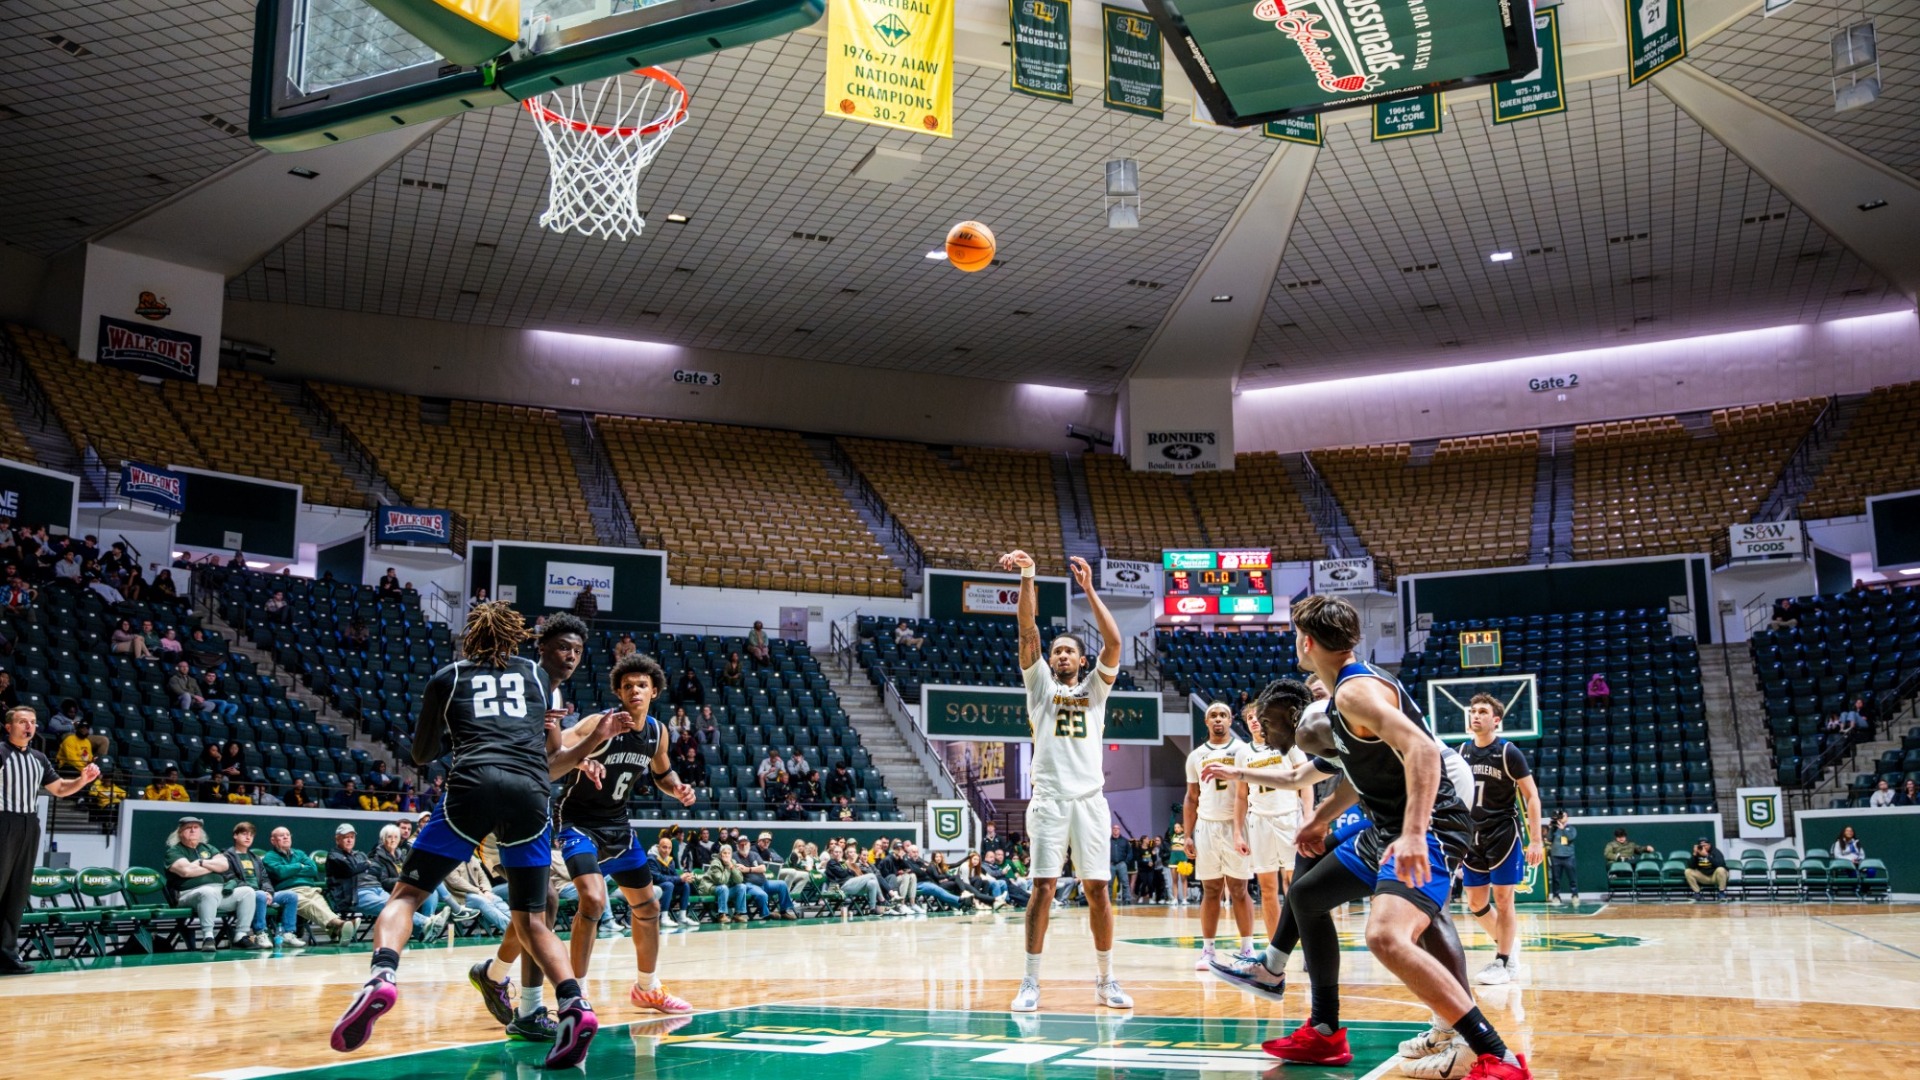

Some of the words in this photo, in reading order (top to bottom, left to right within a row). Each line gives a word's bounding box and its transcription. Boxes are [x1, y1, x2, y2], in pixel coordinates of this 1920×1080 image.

[1261, 3, 1277, 17] 55
[1647, 6, 1660, 24] 21
[1019, 24, 1064, 40] Women's
[1016, 34, 1067, 50] Basketball
[1115, 46, 1155, 61] Women's
[1411, 31, 1432, 71] PARISH
[843, 44, 897, 66] 1976-77
[902, 57, 938, 75] AIAW
[1111, 54, 1160, 70] Basketball
[855, 65, 926, 90] NATIONAL
[1018, 75, 1067, 92] 2022-2023
[847, 82, 933, 110] CHAMPIONS
[1125, 94, 1147, 106] 2023
[1323, 85, 1423, 107] www.tangitourism.com
[1500, 97, 1521, 108] QUEEN
[1521, 91, 1558, 105] BRUMFIELD
[874, 106, 906, 123] 30-2
[1385, 115, 1399, 124] C.A.
[1402, 111, 1425, 121] CORE
[1396, 123, 1414, 131] 1975
[674, 370, 708, 384] Gate
[712, 373, 721, 385] 3
[1529, 377, 1565, 390] Gate
[1569, 374, 1579, 386] 2
[1147, 432, 1215, 446] RONNIE'S
[1148, 461, 1175, 470] Boudin
[1177, 462, 1183, 470] &
[1185, 461, 1216, 470] Cracklin
[1743, 523, 1785, 540] S&W
[1747, 542, 1785, 553] FOODS
[1106, 561, 1150, 573] RONNIE'S
[1319, 560, 1368, 571] RONNIE'S
[549, 574, 564, 585] La
[567, 576, 611, 589] Capitol
[1175, 578, 1189, 589] 76
[1251, 578, 1265, 589] 76
[1222, 585, 1229, 595] 2
[472, 673, 527, 718] 23
[1055, 709, 1087, 738] 23
[604, 752, 626, 765] NEW
[1473, 764, 1502, 780] ORLEANS
[612, 772, 632, 800] 6
[1752, 802, 1768, 820] S
[941, 813, 956, 832] S
[744, 1026, 1263, 1050] OUTHLAND
